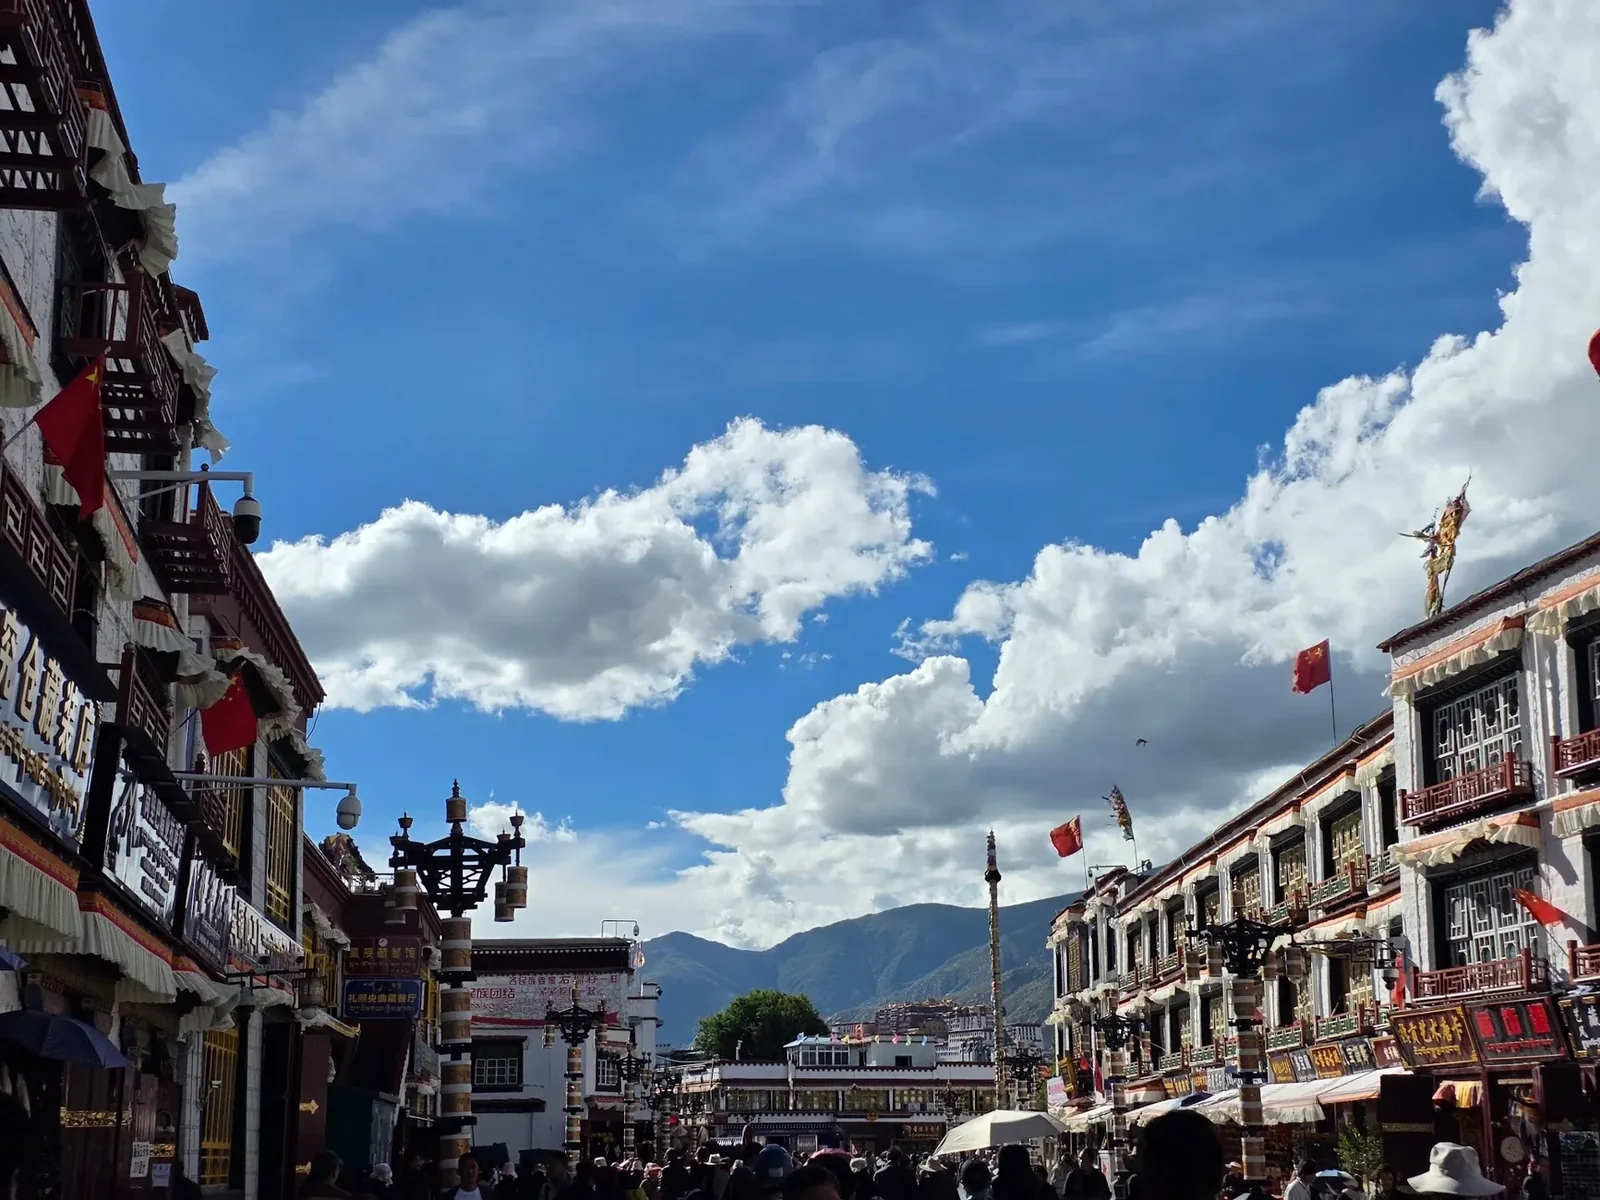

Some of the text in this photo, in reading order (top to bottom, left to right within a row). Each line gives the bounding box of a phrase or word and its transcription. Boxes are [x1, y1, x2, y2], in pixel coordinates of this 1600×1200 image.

[540, 986, 597, 996] 紧紧抱一起
